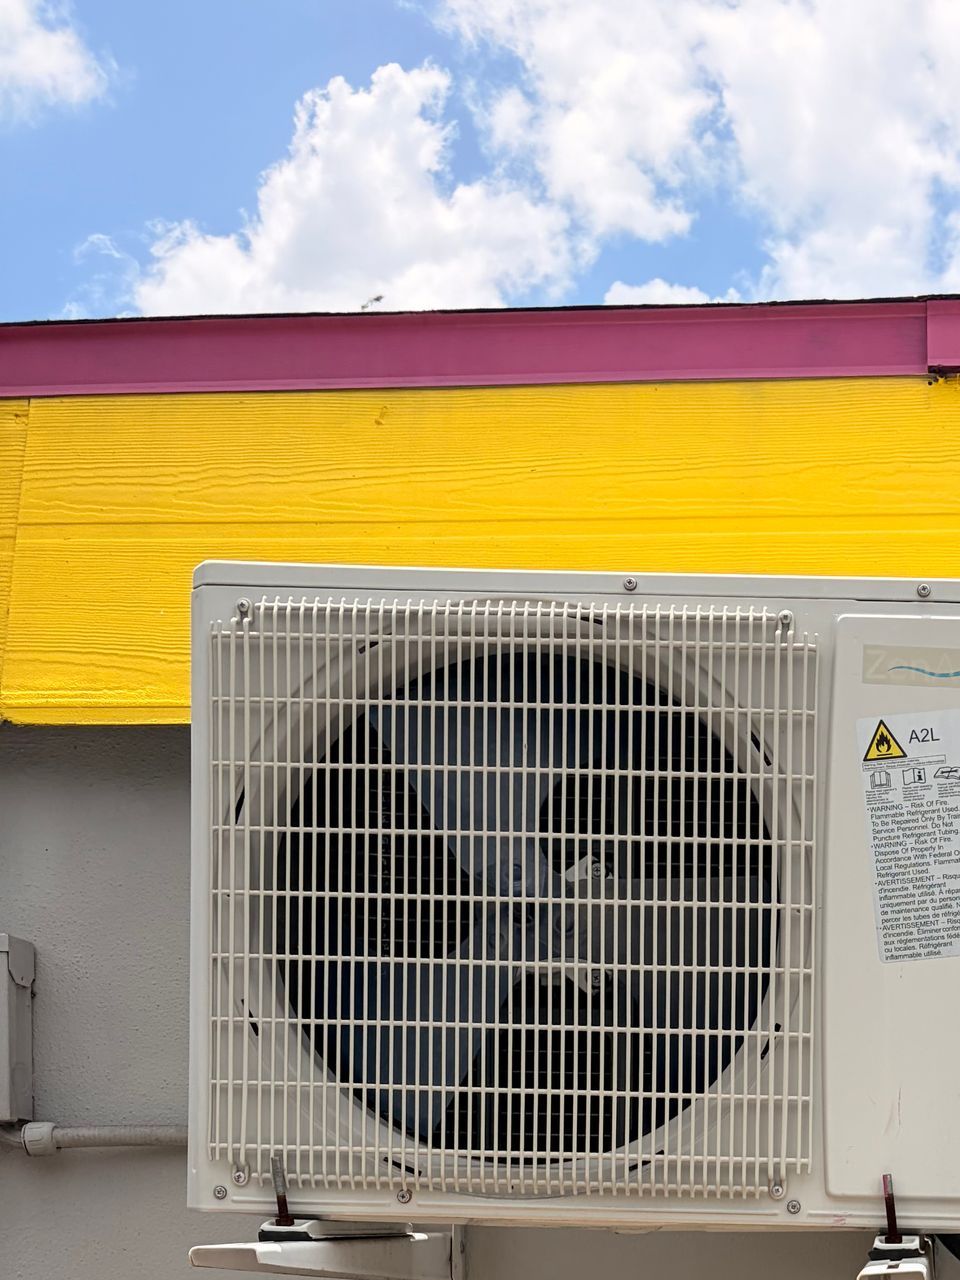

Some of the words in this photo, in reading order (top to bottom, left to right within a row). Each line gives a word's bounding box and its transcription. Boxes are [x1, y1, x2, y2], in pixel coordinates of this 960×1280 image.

[909, 727, 940, 744] A2L
[870, 811, 904, 820] Flammable
[907, 808, 940, 818] Refrigerant
[891, 817, 919, 826] Repaired
[921, 815, 935, 823] Only
[902, 830, 936, 840] Refrigerant
[874, 849, 899, 858] Dispose
[911, 845, 936, 854] Properly
[875, 856, 911, 864] Accordance
[929, 850, 952, 858] Federal
[877, 870, 911, 880] Refrigerant
[880, 893, 916, 901] inflammable
[880, 900, 916, 909] uniquement
[890, 905, 929, 914] maintenance
[886, 952, 922, 960] inflammable
